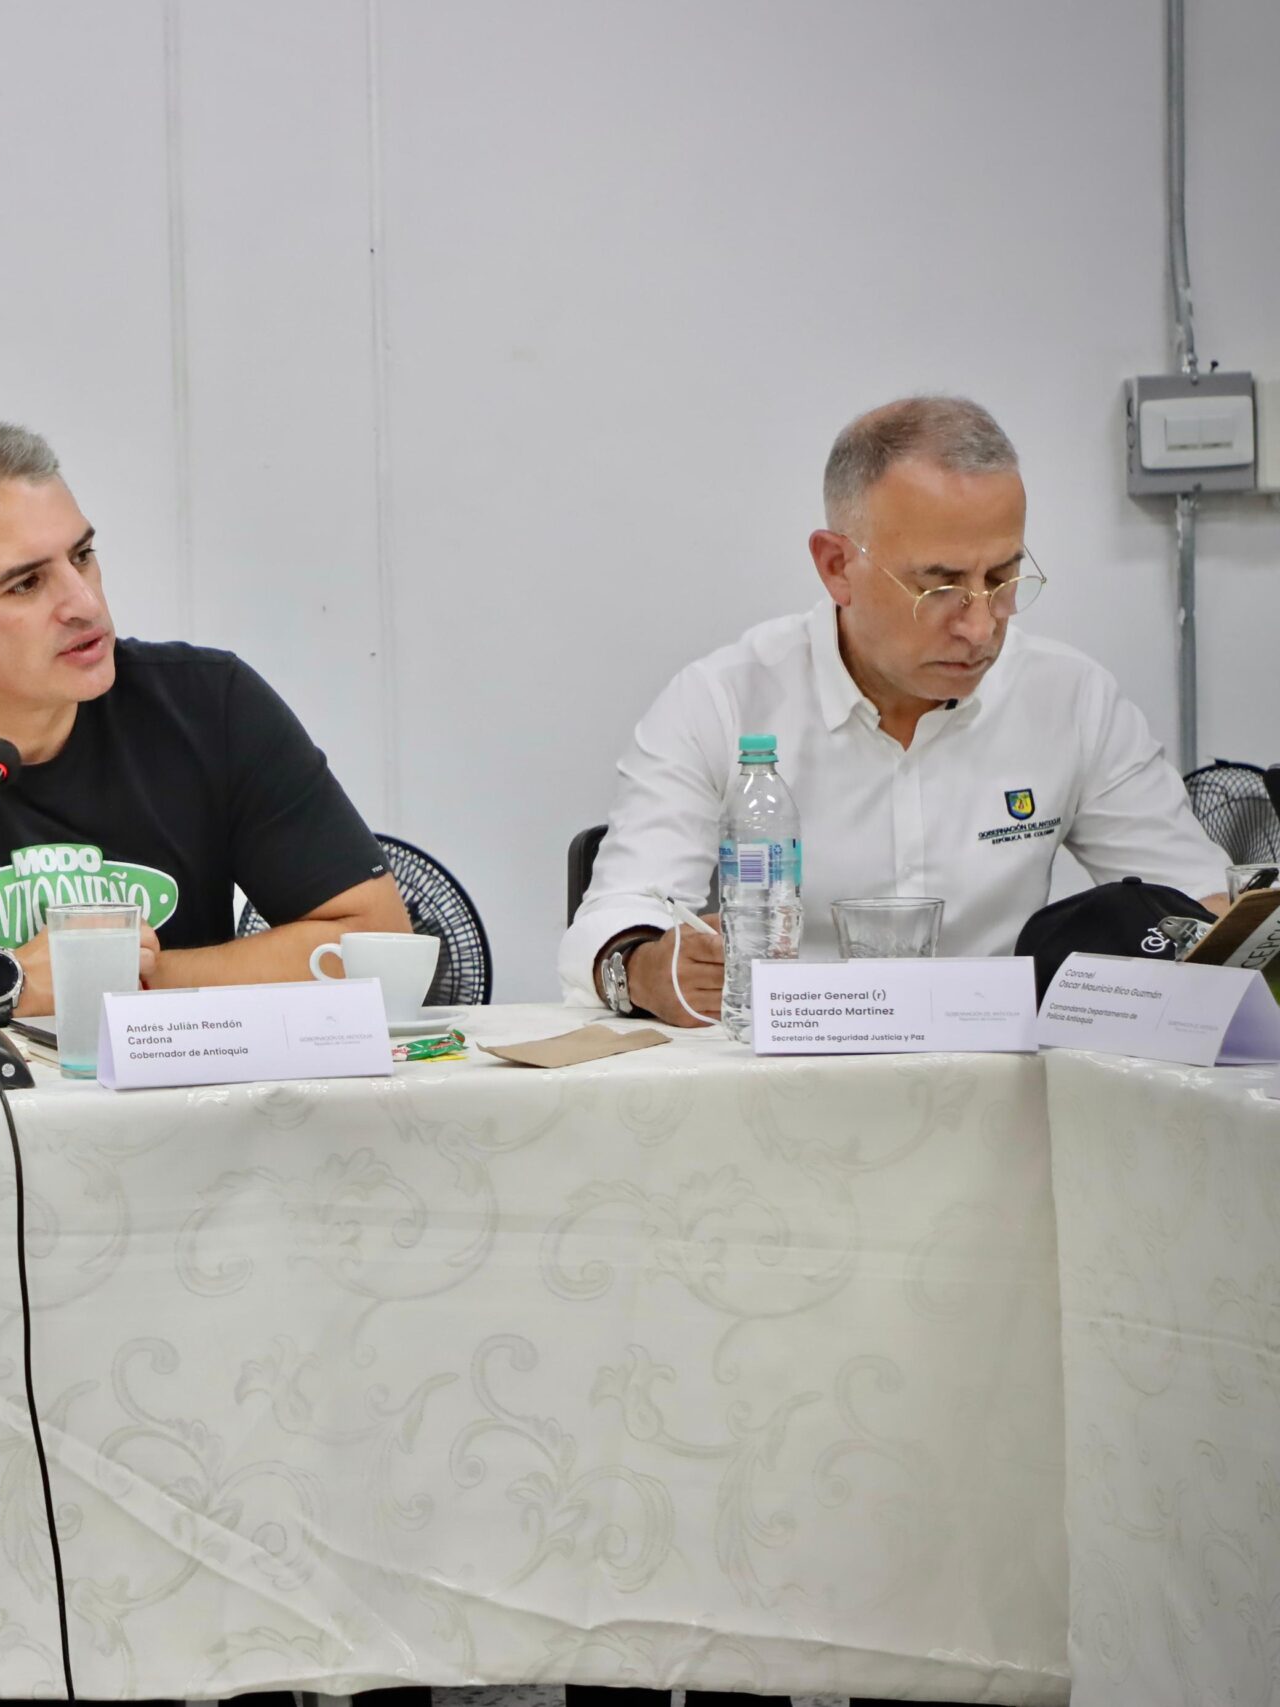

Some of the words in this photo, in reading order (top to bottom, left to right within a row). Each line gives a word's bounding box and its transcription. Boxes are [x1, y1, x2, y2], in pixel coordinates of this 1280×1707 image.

[13, 847, 102, 877] MODO
[1064, 968, 1096, 979] Coronel
[1058, 979, 1081, 989] Oscar
[1081, 982, 1114, 994] Mauricio
[770, 991, 822, 1003] Brigadier
[824, 991, 869, 1000] General
[871, 988, 887, 1002] (r)
[770, 1007, 793, 1017] Luis
[794, 1007, 843, 1017] Eduardo
[126, 1023, 164, 1033] Andrés
[166, 1022, 199, 1032] Julián
[201, 1019, 243, 1030] Rendón
[770, 1019, 819, 1029] Guzmán
[127, 1035, 173, 1046] Cardona
[814, 1034, 826, 1042] de
[826, 1034, 870, 1043] Seguridad
[870, 1033, 903, 1041] Justicia
[910, 1033, 925, 1041] Paz
[129, 1049, 187, 1060] Gobernador
[188, 1048, 201, 1057] de
[203, 1046, 249, 1057] Antioquia
